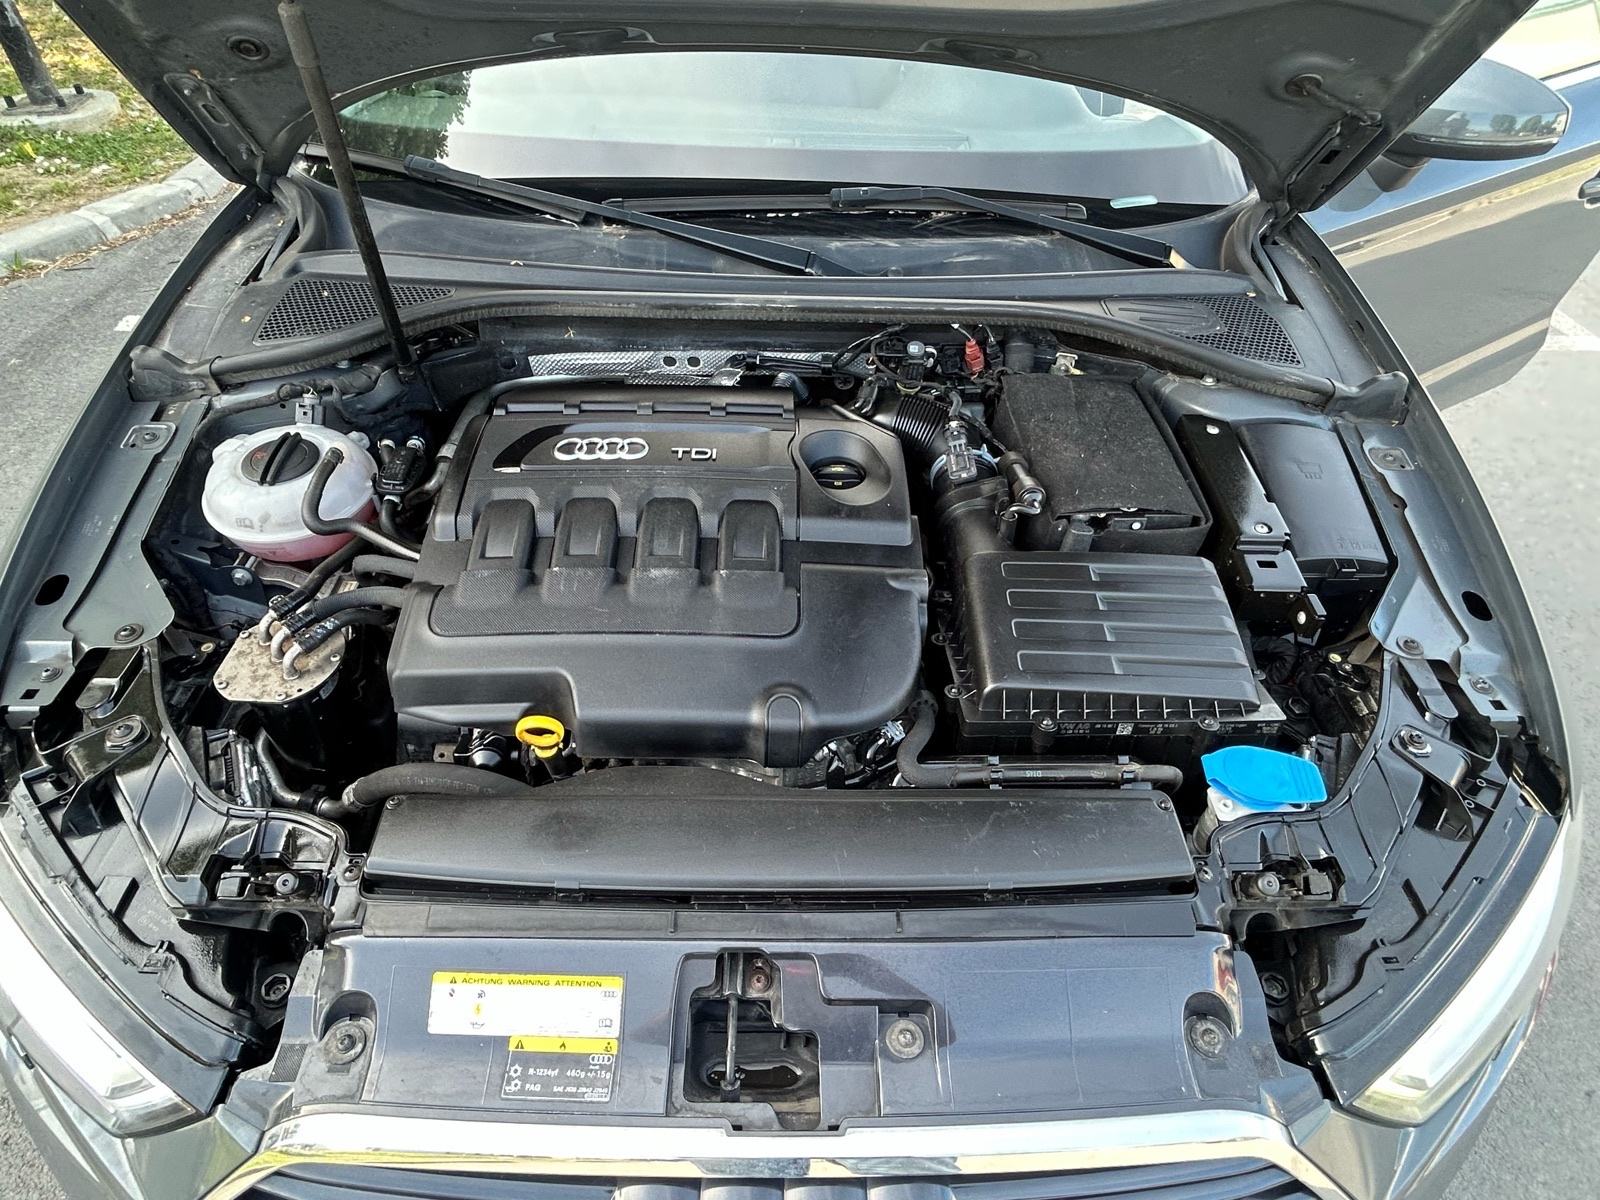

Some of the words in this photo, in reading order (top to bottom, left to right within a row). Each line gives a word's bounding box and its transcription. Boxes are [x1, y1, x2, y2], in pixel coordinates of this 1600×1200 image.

[671, 447, 718, 461] TDI
[507, 978, 550, 986] WARNING
[528, 1068, 558, 1077] R-1234yf
[525, 1084, 541, 1092] PAG
